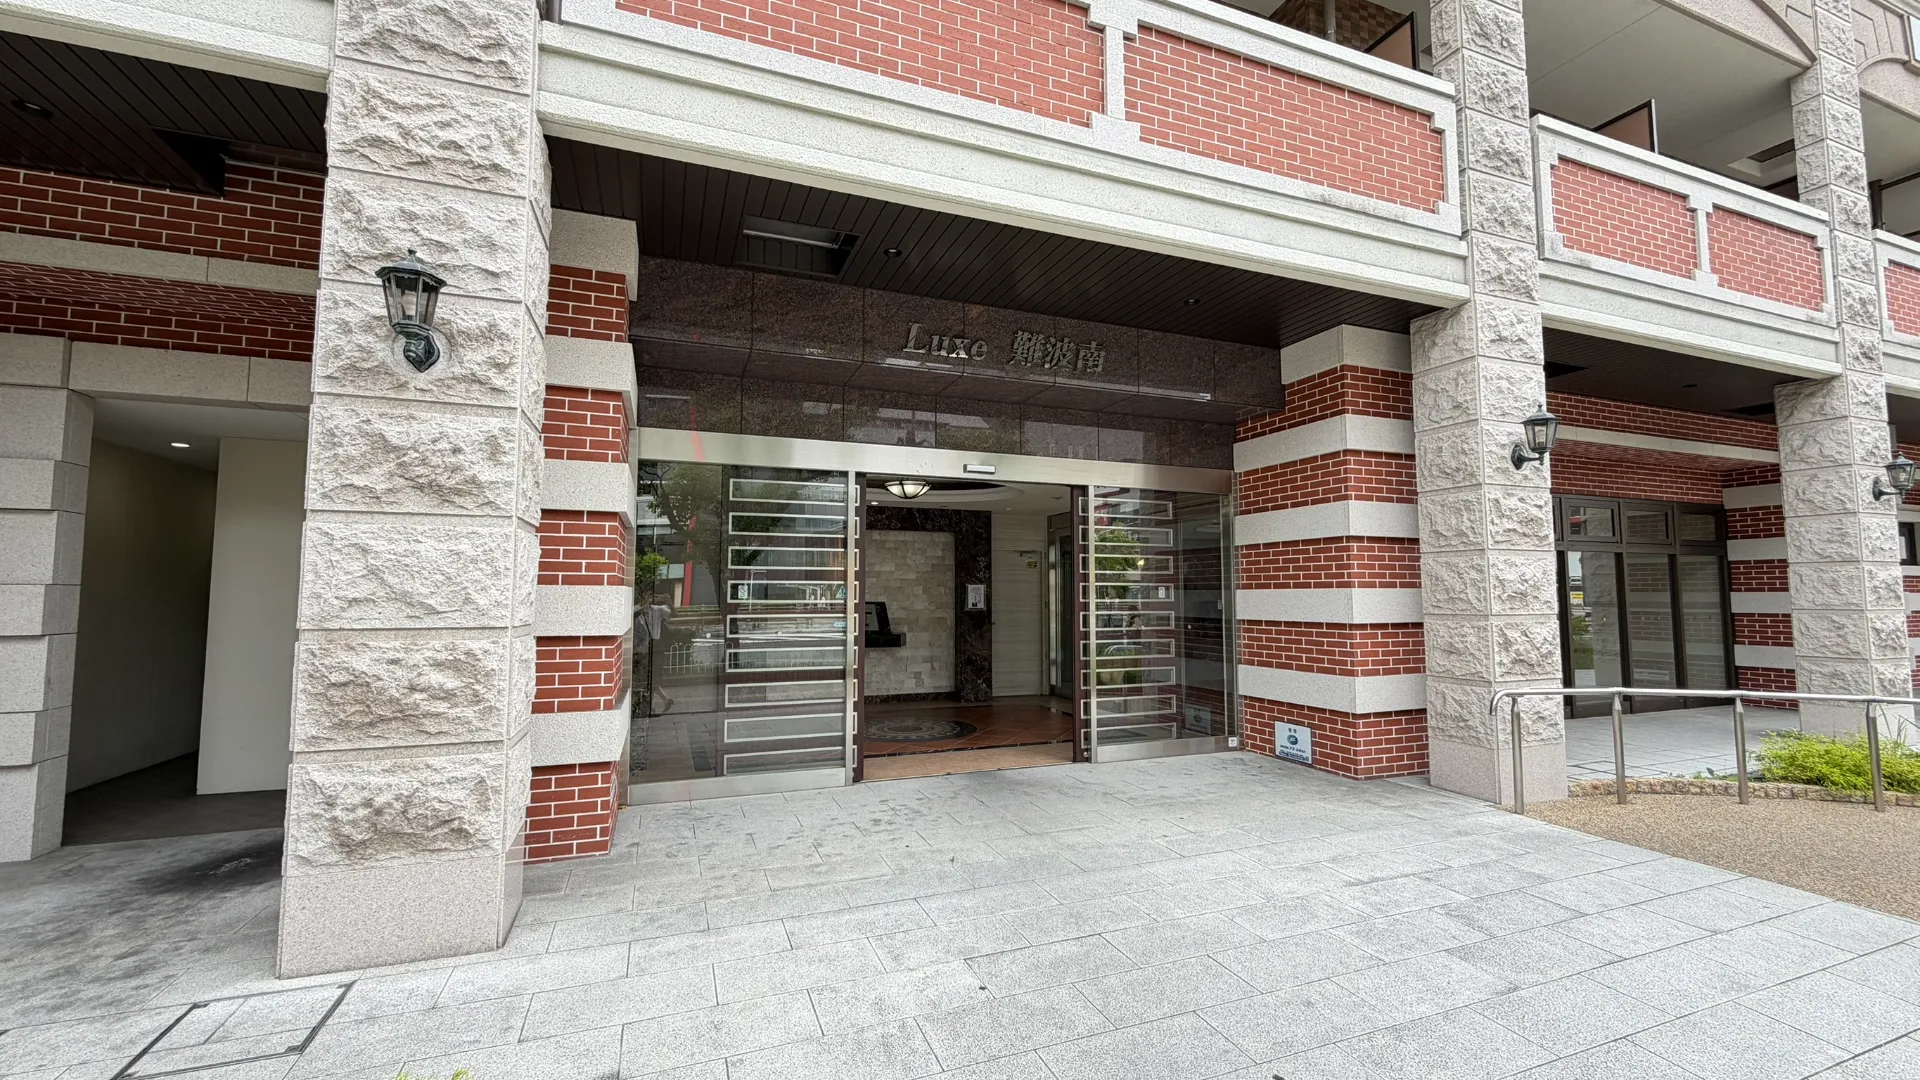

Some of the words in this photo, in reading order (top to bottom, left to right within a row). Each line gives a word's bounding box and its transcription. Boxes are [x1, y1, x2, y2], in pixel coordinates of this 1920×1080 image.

[902, 322, 988, 361] Luxe
[1009, 331, 1106, 373] 難波南
